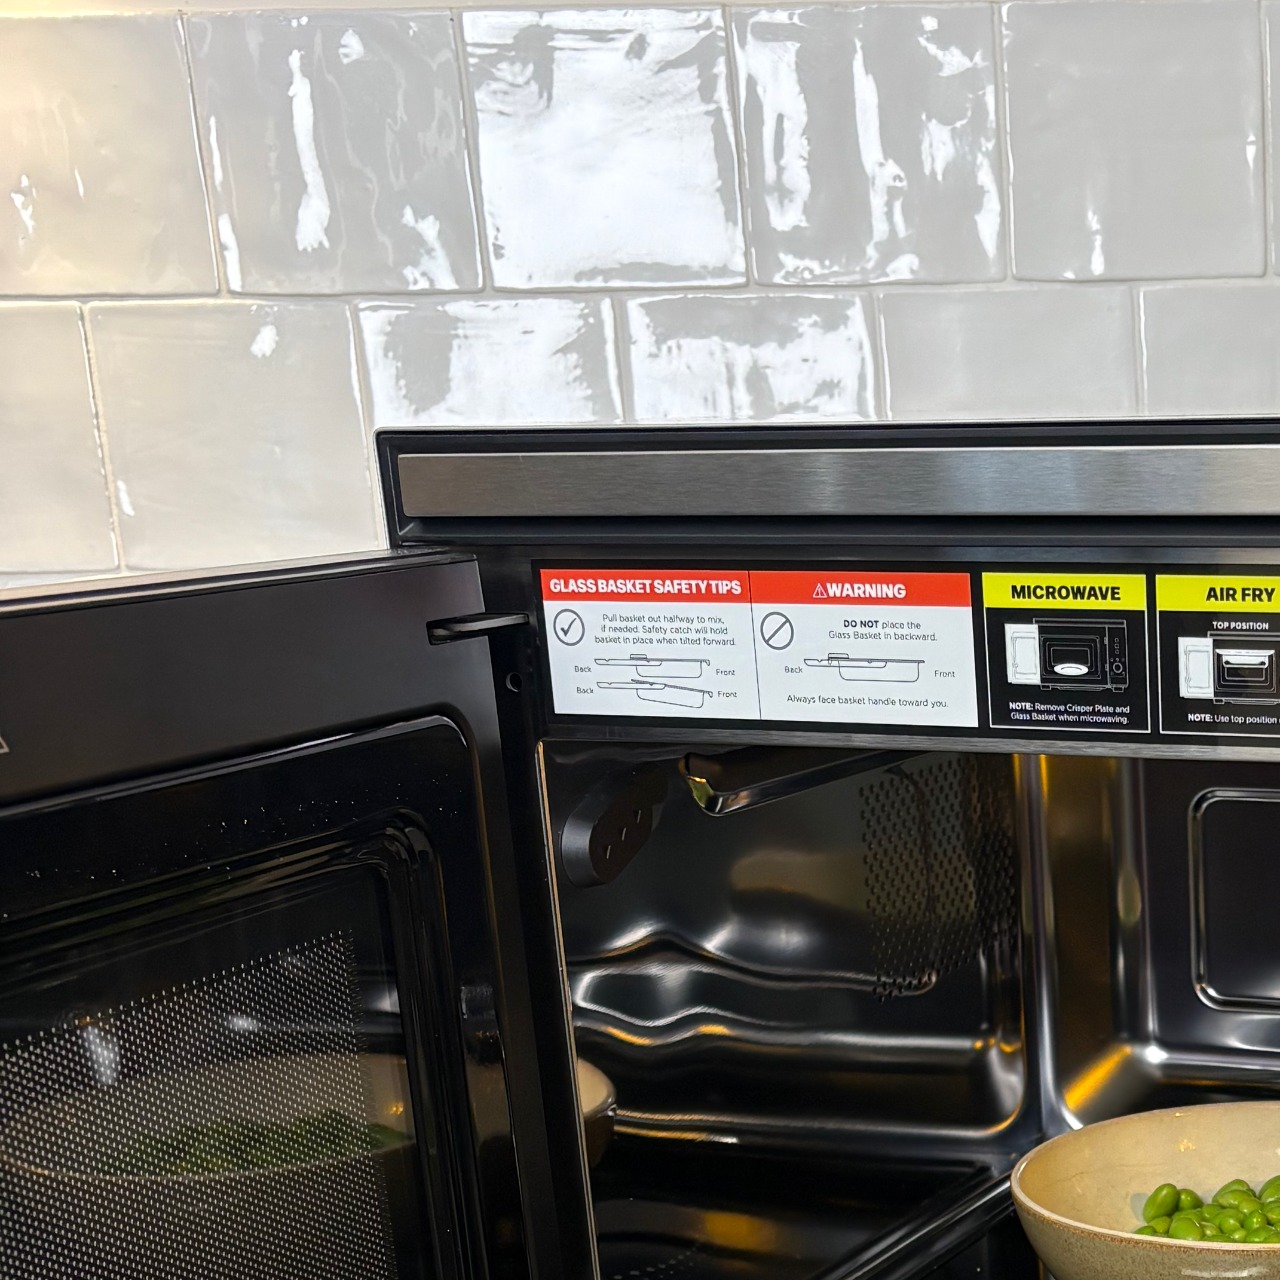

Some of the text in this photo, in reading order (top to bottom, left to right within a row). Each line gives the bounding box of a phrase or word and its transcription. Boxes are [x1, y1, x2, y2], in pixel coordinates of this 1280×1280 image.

[549, 578, 742, 594] GLASS BASKET SAFETY TIPS
[827, 582, 906, 598] WARNING
[1011, 584, 1121, 600] MICROWAVE
[1206, 586, 1276, 602] AIR FRY
[843, 619, 921, 629] DO NOT place the
[1212, 621, 1269, 630] TOP POSITION
[1066, 703, 1093, 713] Crisper
[1115, 705, 1130, 713] and
[1214, 714, 1230, 722] Use
[1230, 715, 1244, 724] top
[1246, 716, 1277, 724] position
